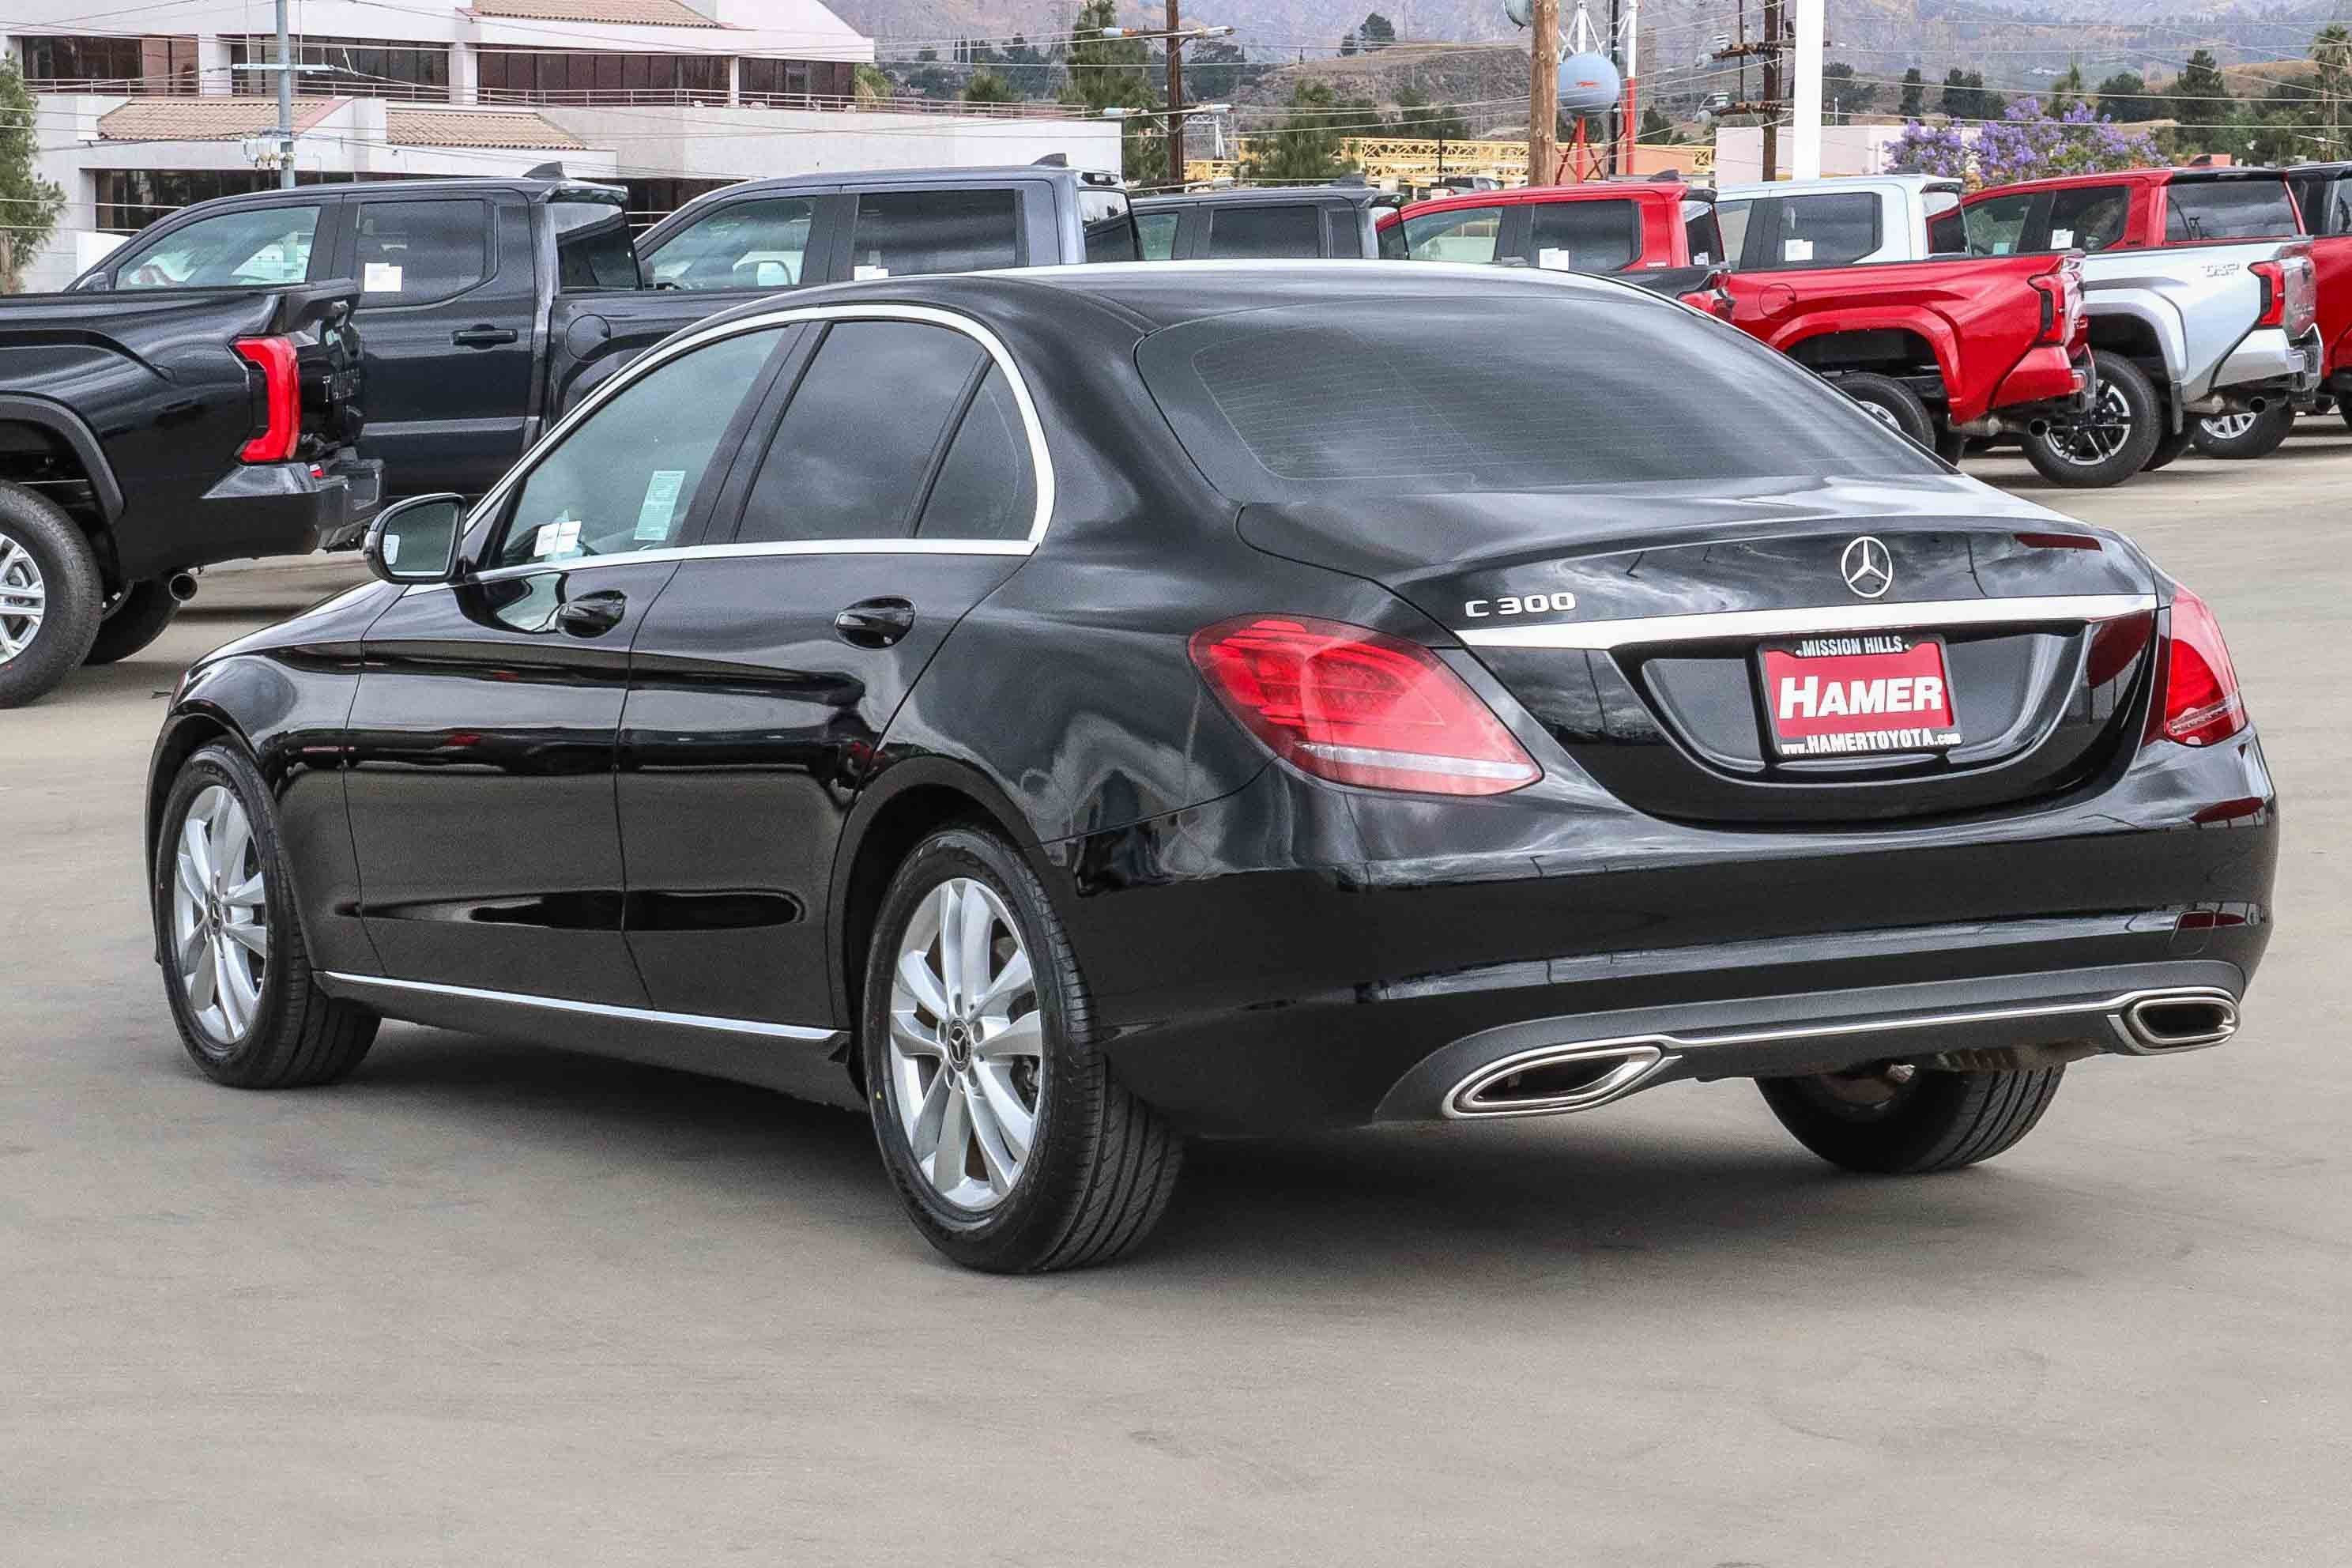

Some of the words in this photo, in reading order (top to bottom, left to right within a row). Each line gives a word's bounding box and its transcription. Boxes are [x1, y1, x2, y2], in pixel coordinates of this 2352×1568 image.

[1465, 600, 1490, 617] C
[1497, 592, 1576, 615] 300
[1801, 638, 1860, 657] MISSION
[1865, 635, 1903, 654] HILLS
[1779, 675, 1943, 720] HAMER
